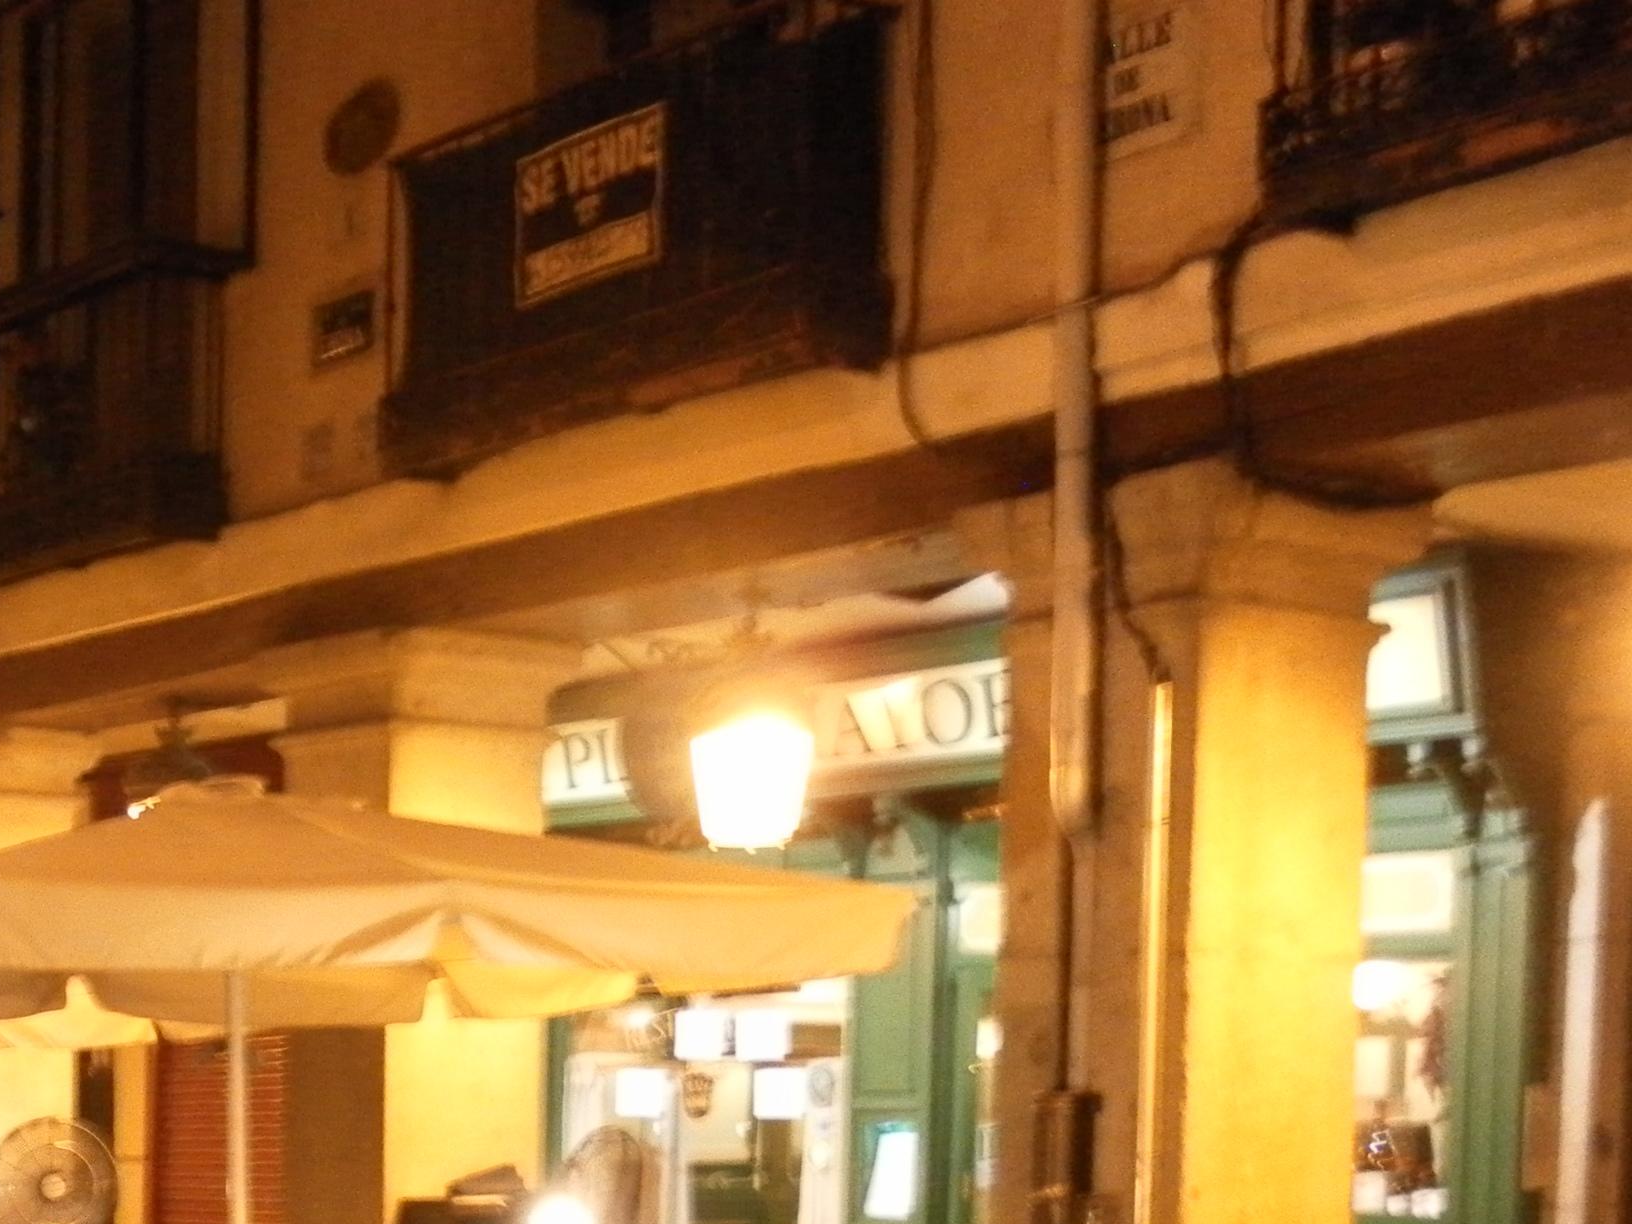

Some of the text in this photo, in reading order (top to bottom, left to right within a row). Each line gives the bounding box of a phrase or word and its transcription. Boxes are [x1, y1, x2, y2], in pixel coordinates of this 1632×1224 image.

[1106, 11, 1172, 60] LLE
[521, 157, 556, 214] SE
[560, 119, 659, 194] VENDE
